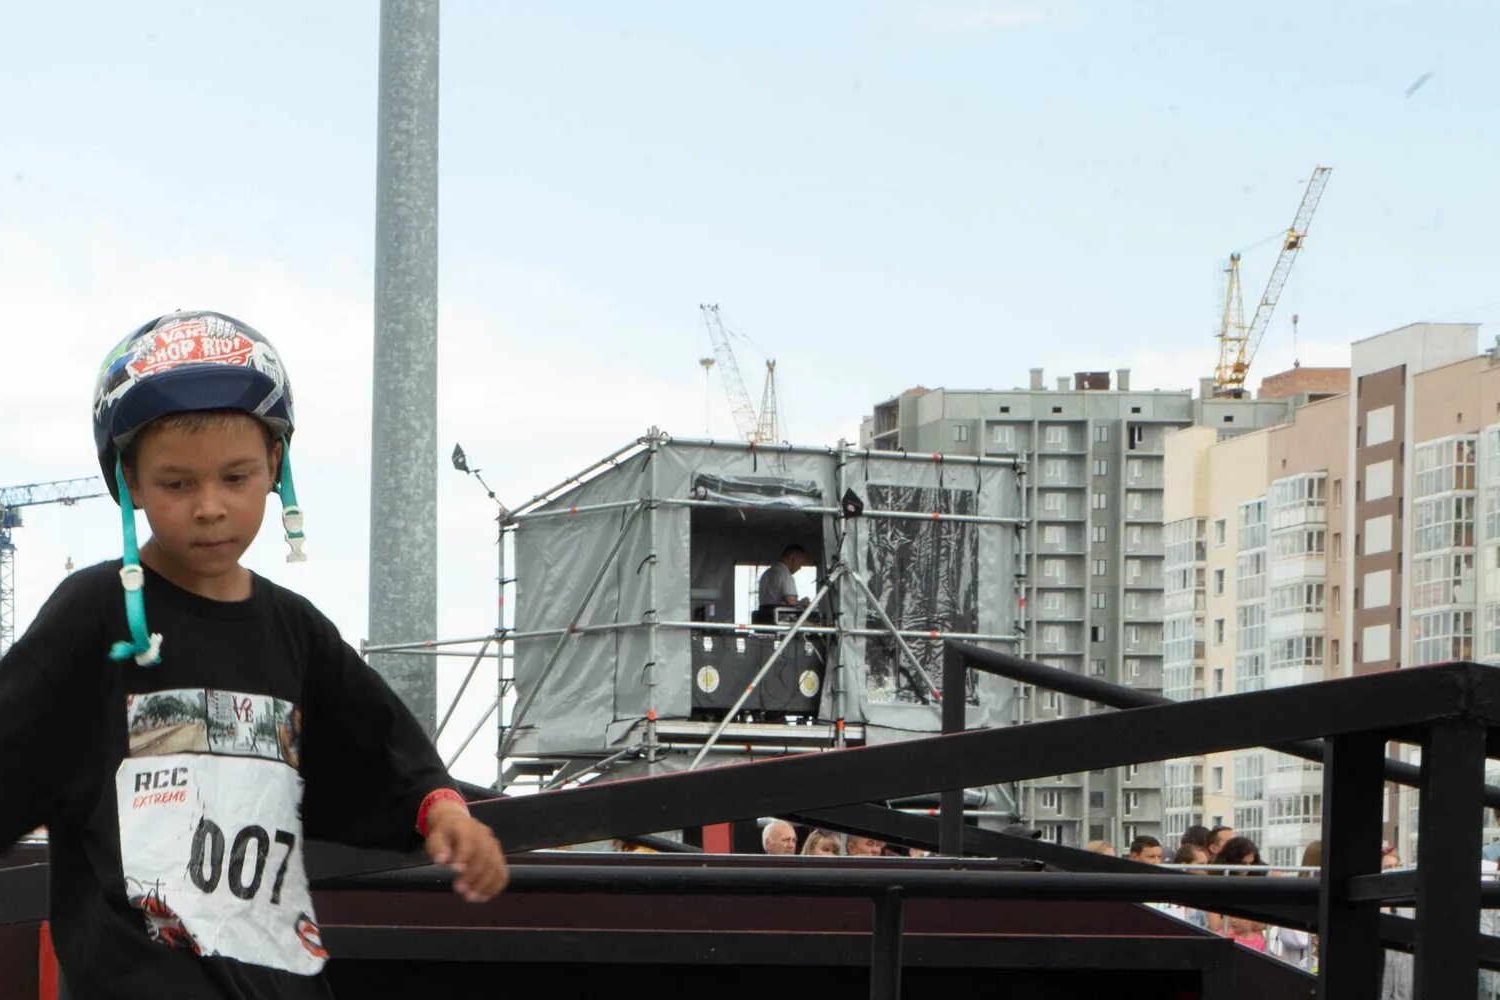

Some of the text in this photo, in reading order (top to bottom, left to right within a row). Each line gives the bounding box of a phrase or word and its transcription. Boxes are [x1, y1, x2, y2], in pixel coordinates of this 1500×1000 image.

[146, 339, 196, 364] SHOP
[134, 767, 188, 793] RCC
[132, 790, 187, 810] EXTREME
[189, 818, 295, 905] 007
